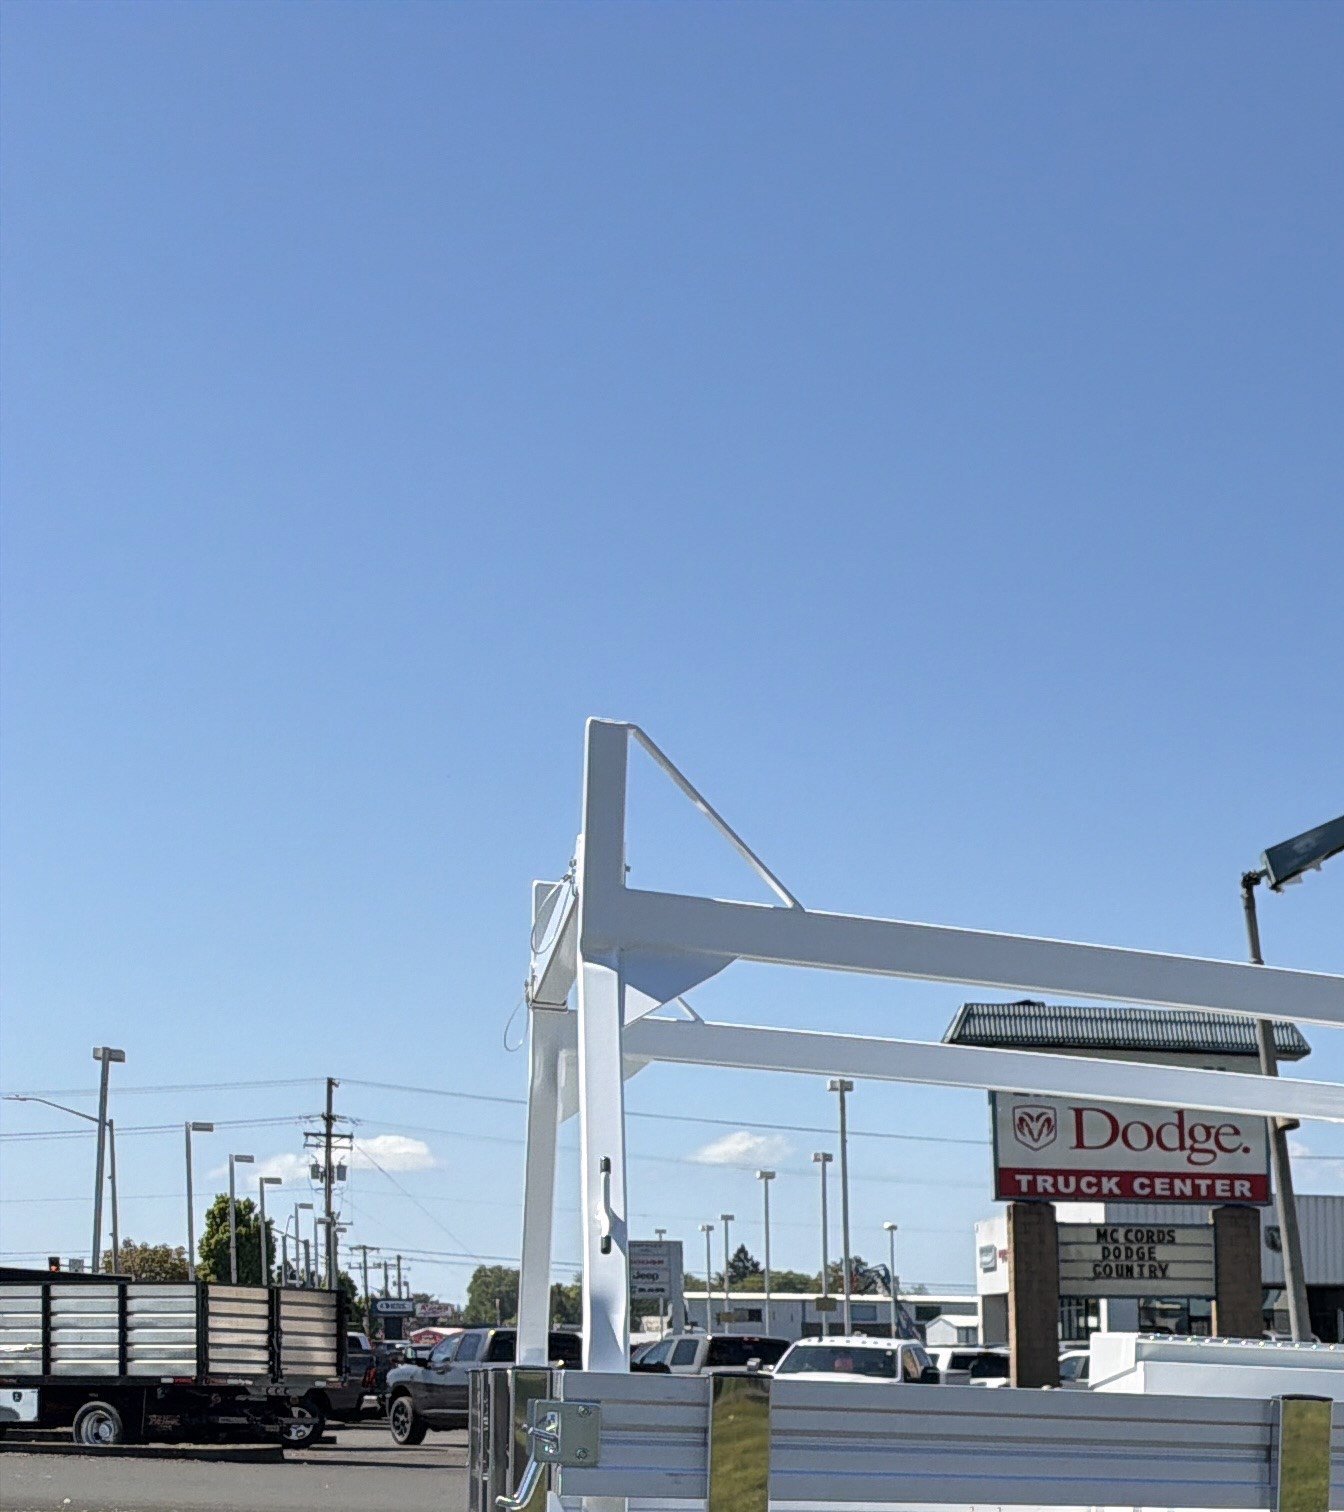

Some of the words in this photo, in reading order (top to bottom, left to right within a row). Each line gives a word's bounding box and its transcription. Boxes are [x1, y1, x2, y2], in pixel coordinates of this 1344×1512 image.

[1014, 1174, 1122, 1196] TRUCK
[1132, 1178, 1253, 1198] CENTER
[1096, 1228, 1120, 1244] MC
[1124, 1228, 1176, 1244] CORDS
[1101, 1246, 1158, 1262] DODGE
[1093, 1263, 1169, 1278] COUNTRY
